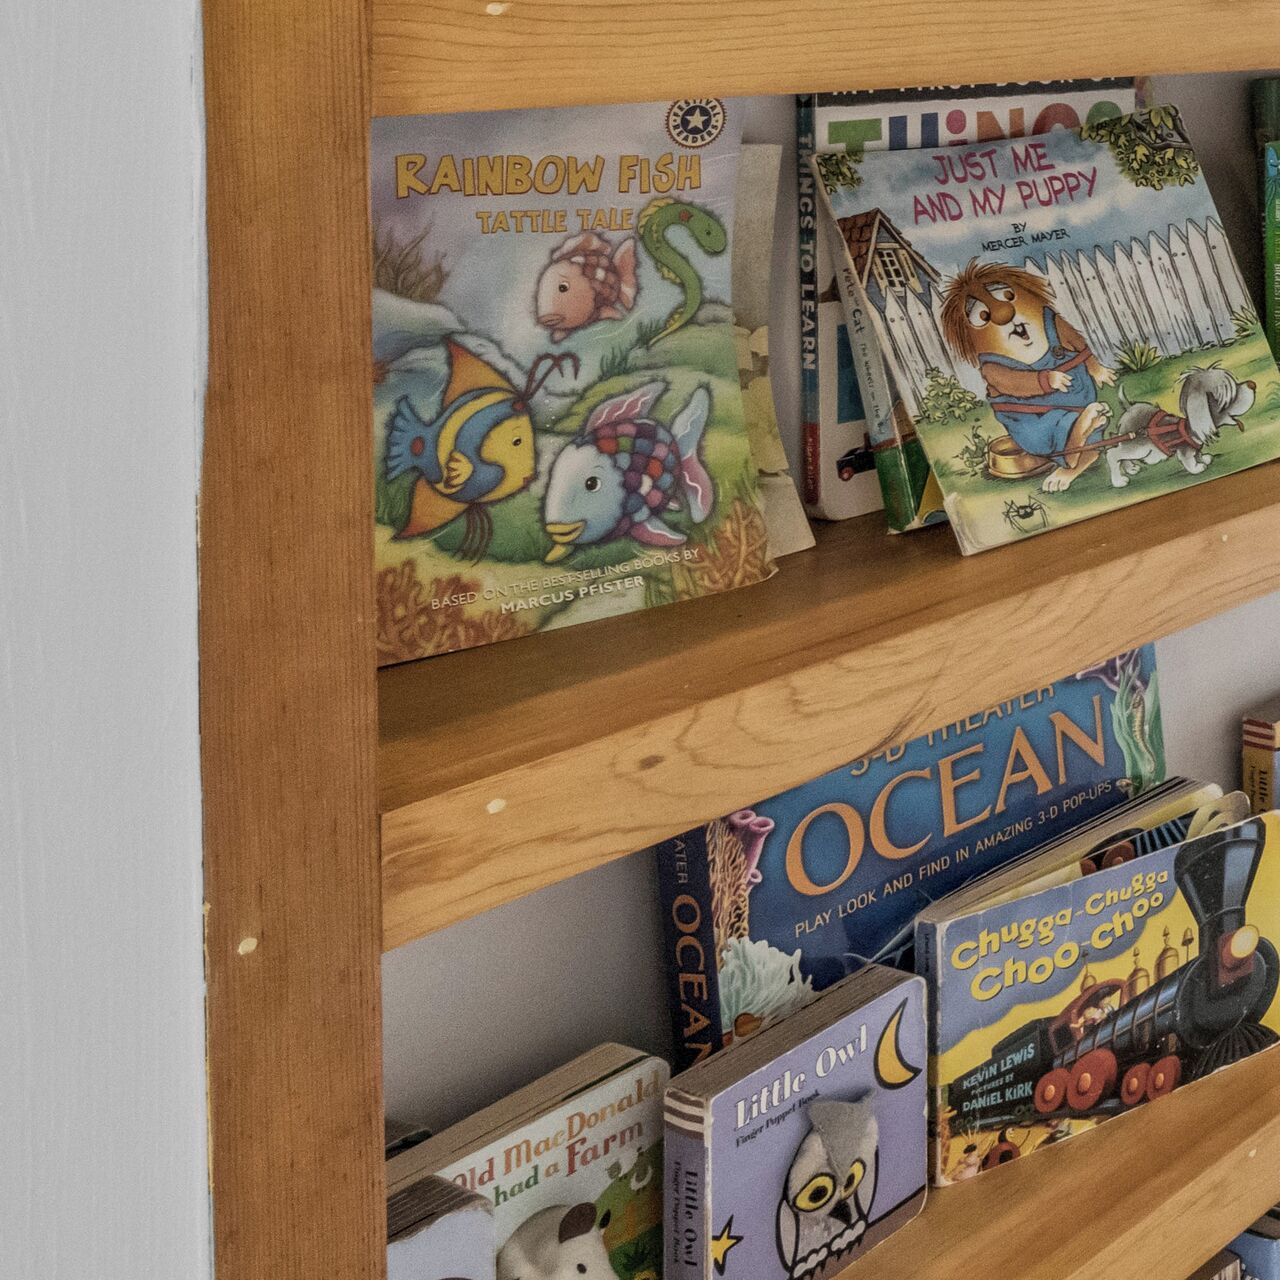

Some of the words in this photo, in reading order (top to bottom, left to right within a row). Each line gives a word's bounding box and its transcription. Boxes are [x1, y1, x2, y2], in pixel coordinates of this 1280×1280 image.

[396, 153, 605, 200] RAINBOW
[619, 152, 702, 194] FISH
[799, 133, 814, 229] THINGS
[934, 148, 998, 186] JUST
[1011, 142, 1056, 173] ME
[476, 209, 567, 235] TATTLE
[577, 208, 634, 232] TALE
[913, 191, 963, 225] AND
[969, 182, 1007, 217] MY
[1020, 167, 1098, 211] PUPPY
[981, 236, 1029, 253] MERCER
[1032, 227, 1070, 244] MAYER
[1011, 222, 1028, 234] BY
[800, 240, 814, 272] TO
[801, 284, 817, 370] LEARN
[500, 589, 576, 615] MARCUS
[578, 575, 645, 600] PFISTER
[785, 695, 1106, 897] OCEAN
[795, 912, 832, 938] PLAY
[838, 890, 877, 918] LOOK
[883, 873, 913, 899] AND
[919, 852, 950, 881] FIND
[955, 845, 970, 863] IN
[974, 816, 1034, 856] AMAZING
[1038, 803, 1059, 825] 3-D
[1063, 779, 1113, 812] POP-UPS
[734, 1070, 806, 1131] Little
[815, 1023, 867, 1078] Owl
[962, 1090, 1004, 1112] DANIEL
[1005, 1081, 1033, 1102] KIRK
[453, 1165, 496, 1195] Old
[502, 1070, 661, 1178] MacDonald
[493, 1171, 541, 1208] had
[544, 1161, 560, 1178] a
[566, 1119, 645, 1180] Farm
